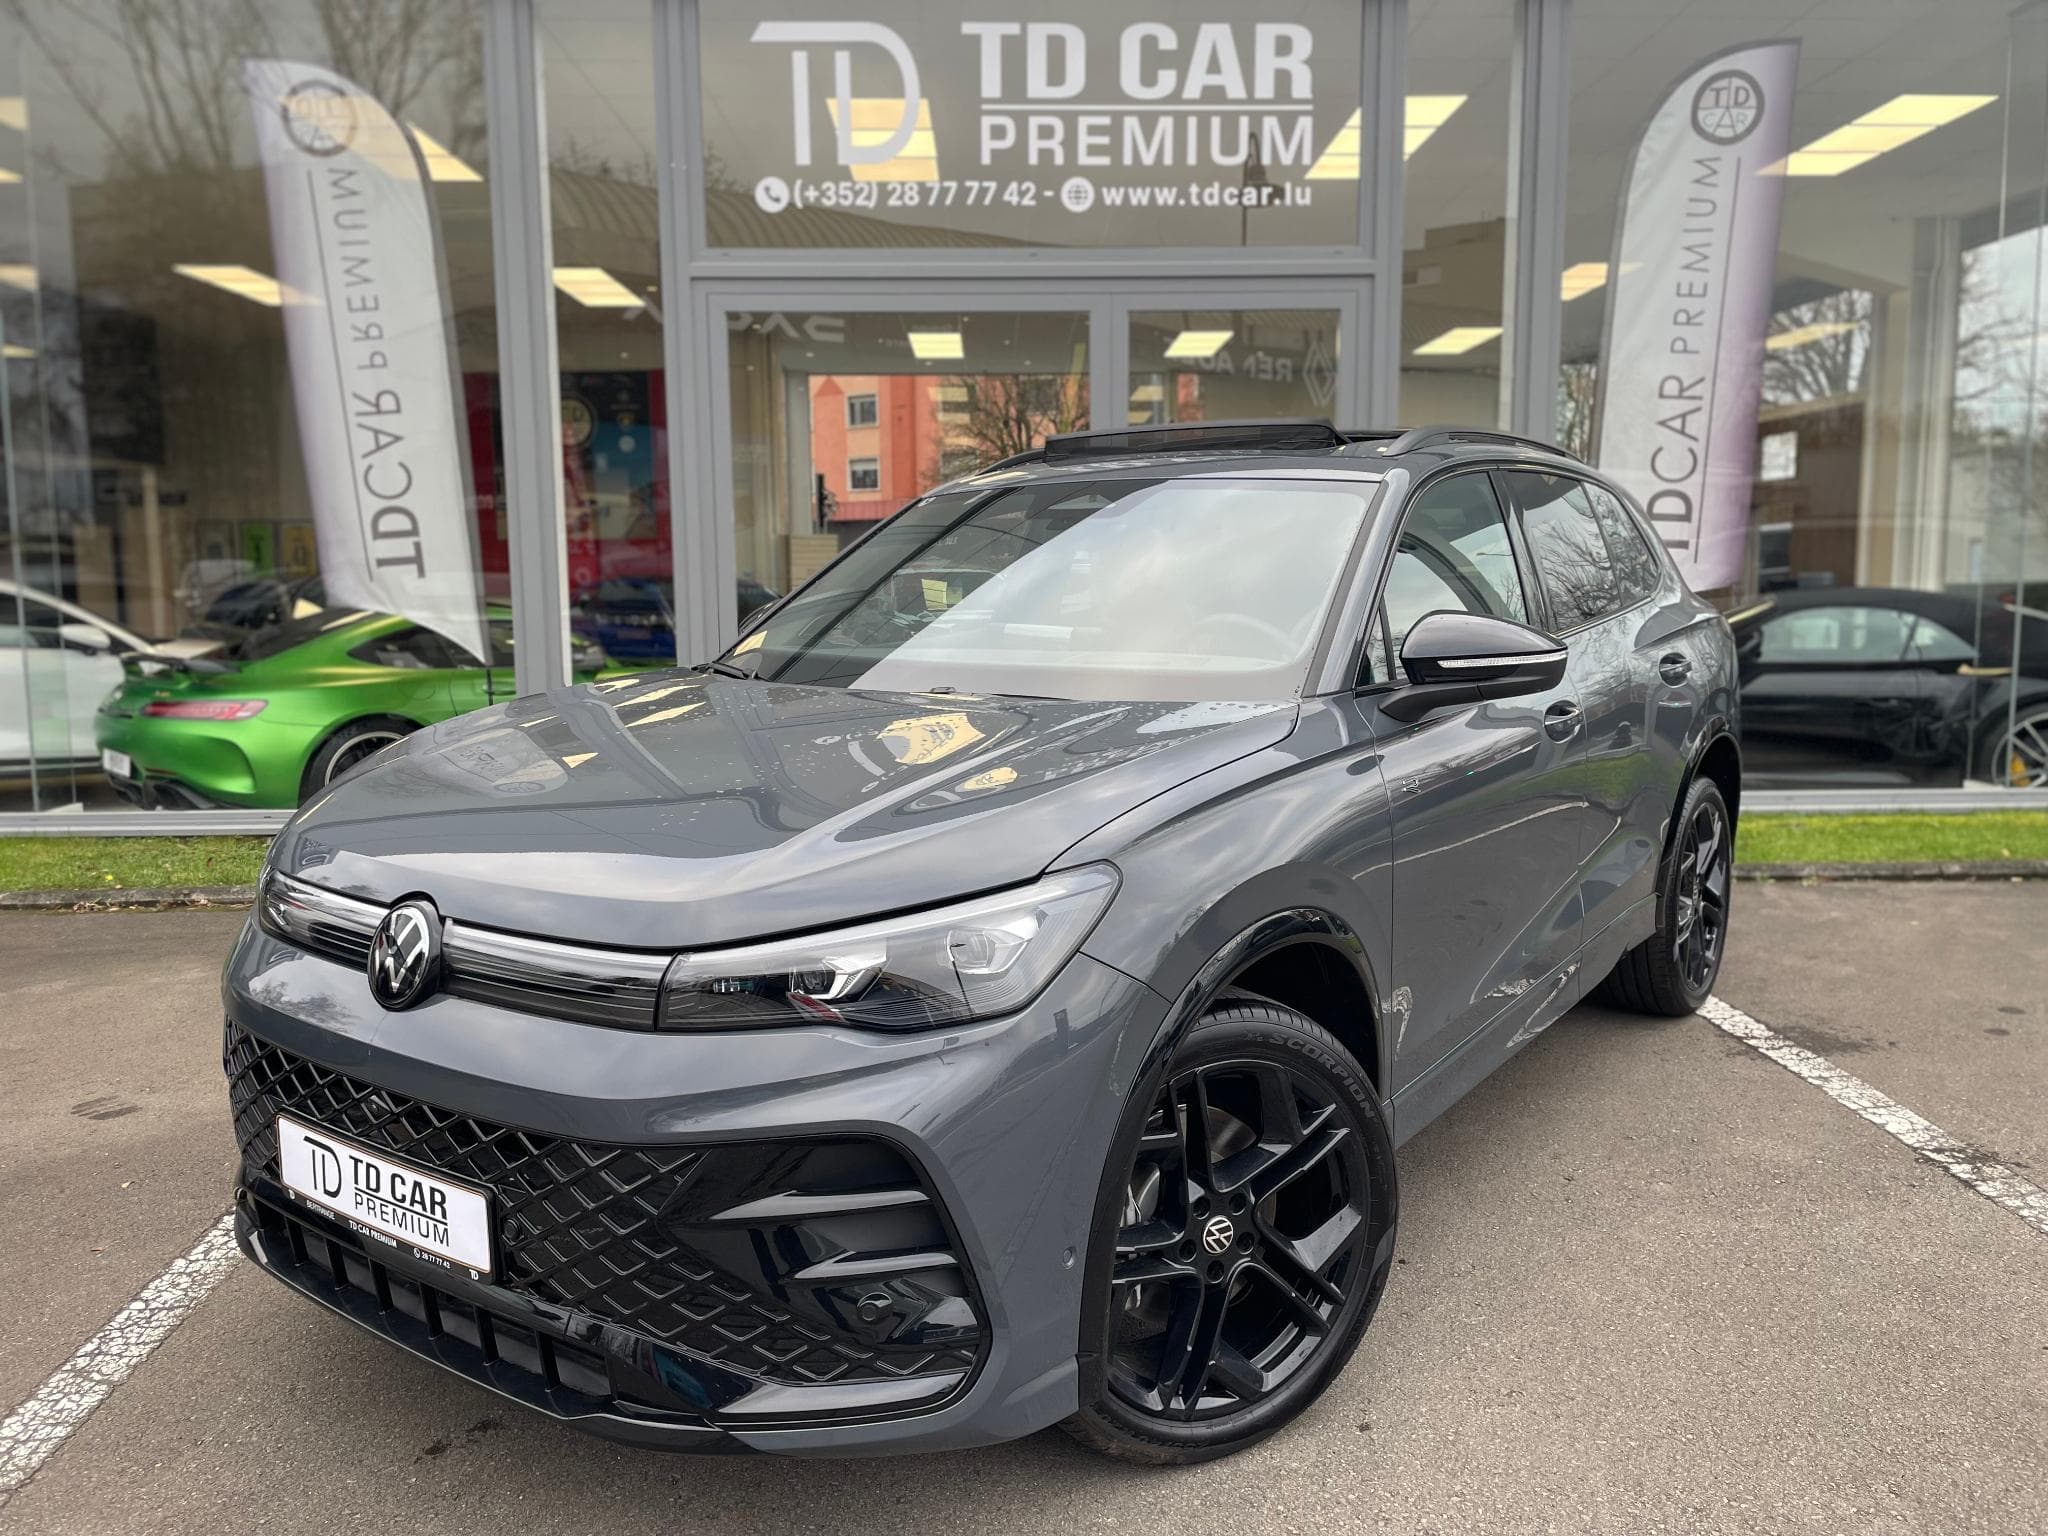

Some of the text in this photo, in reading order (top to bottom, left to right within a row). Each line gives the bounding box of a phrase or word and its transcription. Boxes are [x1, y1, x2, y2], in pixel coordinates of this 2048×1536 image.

[961, 22, 1313, 99] TD CAR
[980, 115, 1313, 165] PREMIUM
[794, 179, 878, 208] (+352)
[887, 181, 920, 206] 28
[925, 181, 957, 206] 77
[964, 181, 997, 206] 77
[1002, 181, 1037, 206] 42
[1101, 181, 1312, 207] www.tdcar.lu
[1670, 156, 1722, 354] PREMIUM
[1268, 1032, 1376, 1119] SCORPION
[349, 1155, 448, 1220] TD CAR
[349, 1220, 398, 1248] TD CAR PREMIUM
[354, 1192, 450, 1247] PREMIUM
[468, 1269, 479, 1281] TD
